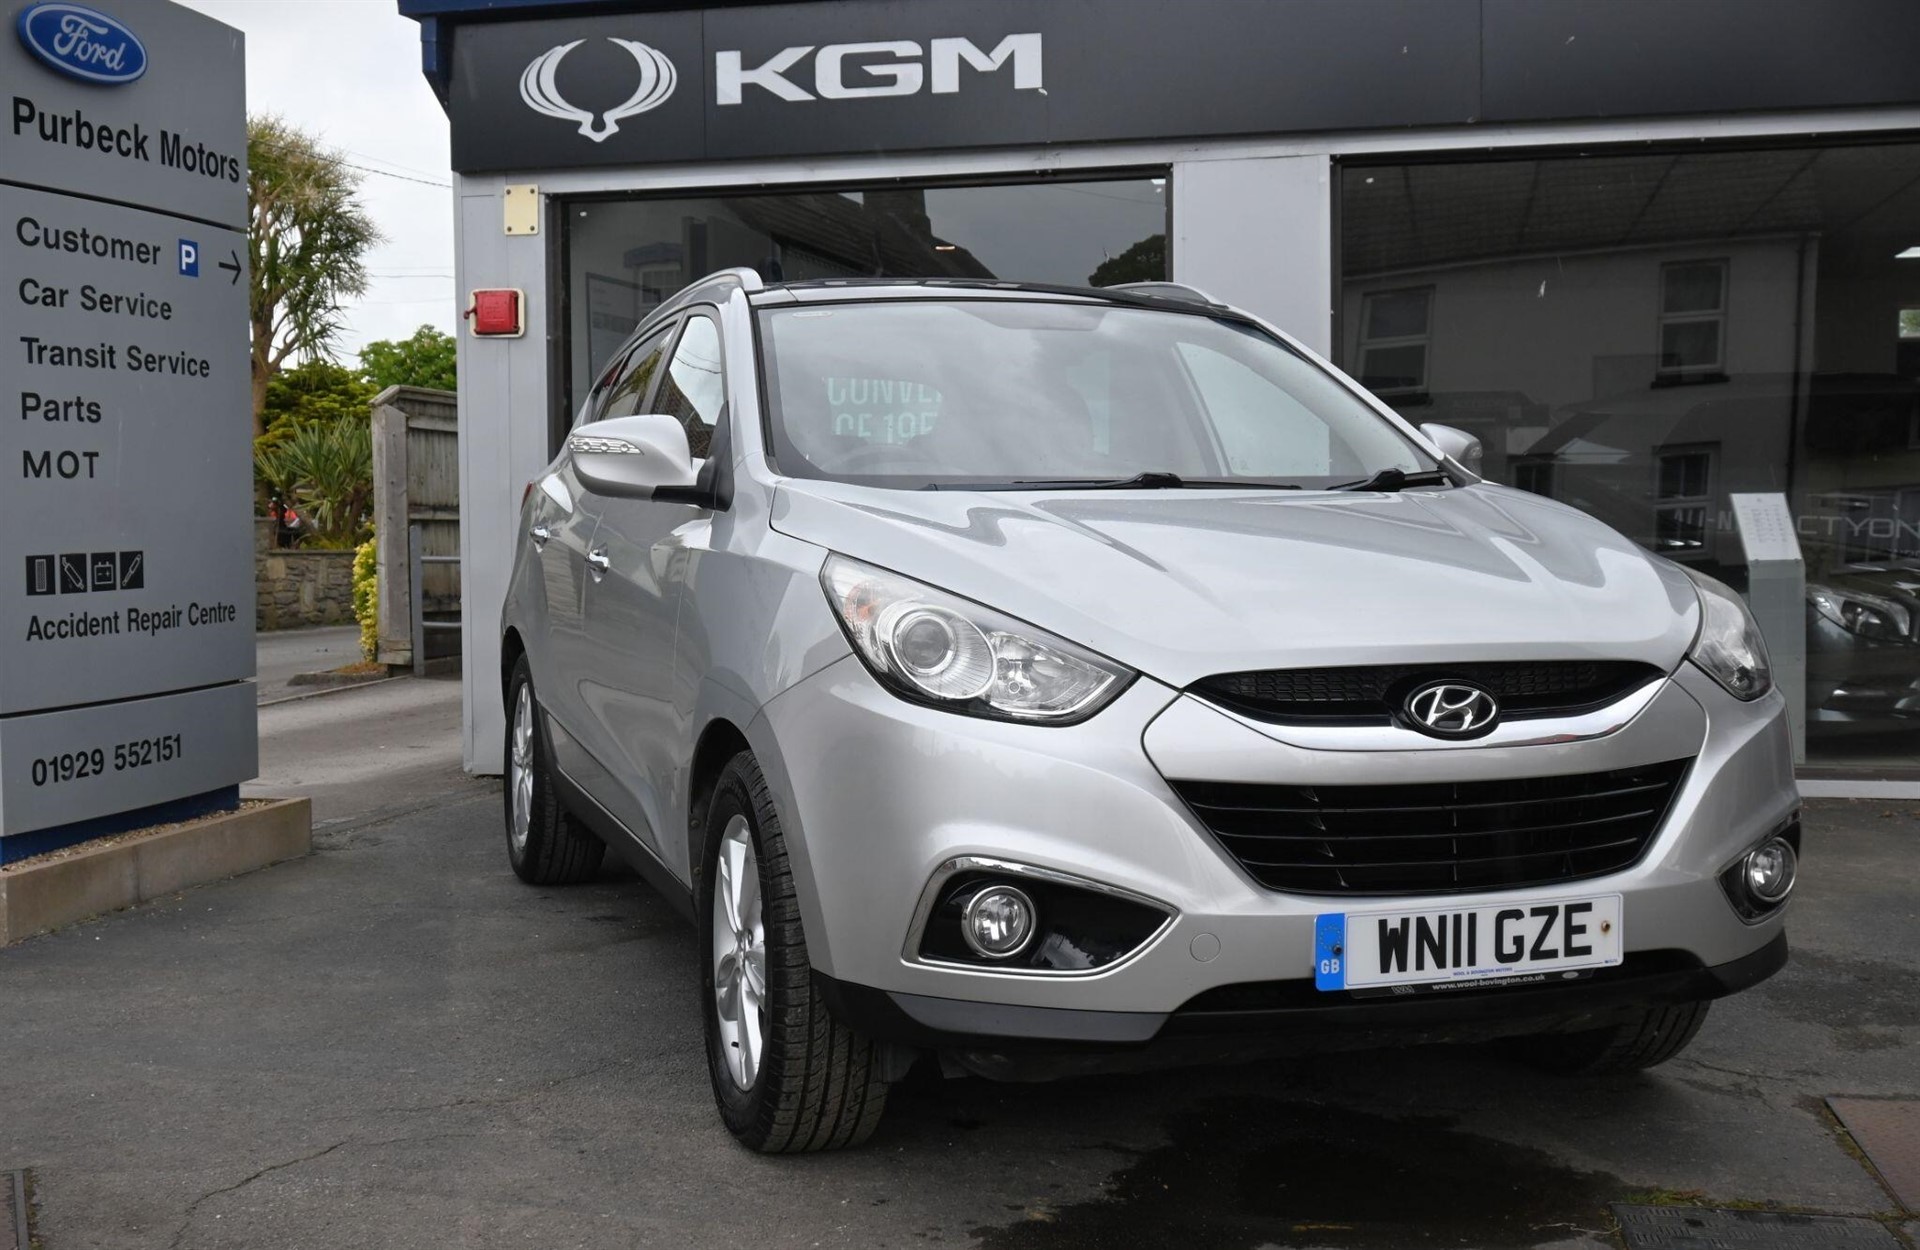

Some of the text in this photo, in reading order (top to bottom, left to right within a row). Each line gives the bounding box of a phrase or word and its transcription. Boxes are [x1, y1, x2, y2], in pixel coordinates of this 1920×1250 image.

[53, 14, 126, 72] Ford
[716, 33, 1042, 105] KGM
[12, 96, 240, 183] Purbeck Motors
[16, 216, 196, 272] Customer P
[19, 278, 172, 320] Car Service
[20, 337, 209, 377] Transit Service
[21, 392, 101, 423] Parts
[23, 450, 99, 479] MOT
[26, 601, 236, 641] Accident Repair Centre
[32, 734, 182, 786] 01929 552151
[1495, 902, 1593, 964] GZE
[1321, 959, 1339, 974] GB
[1432, 974, 1546, 990] www.wool-bovington.co.uk
